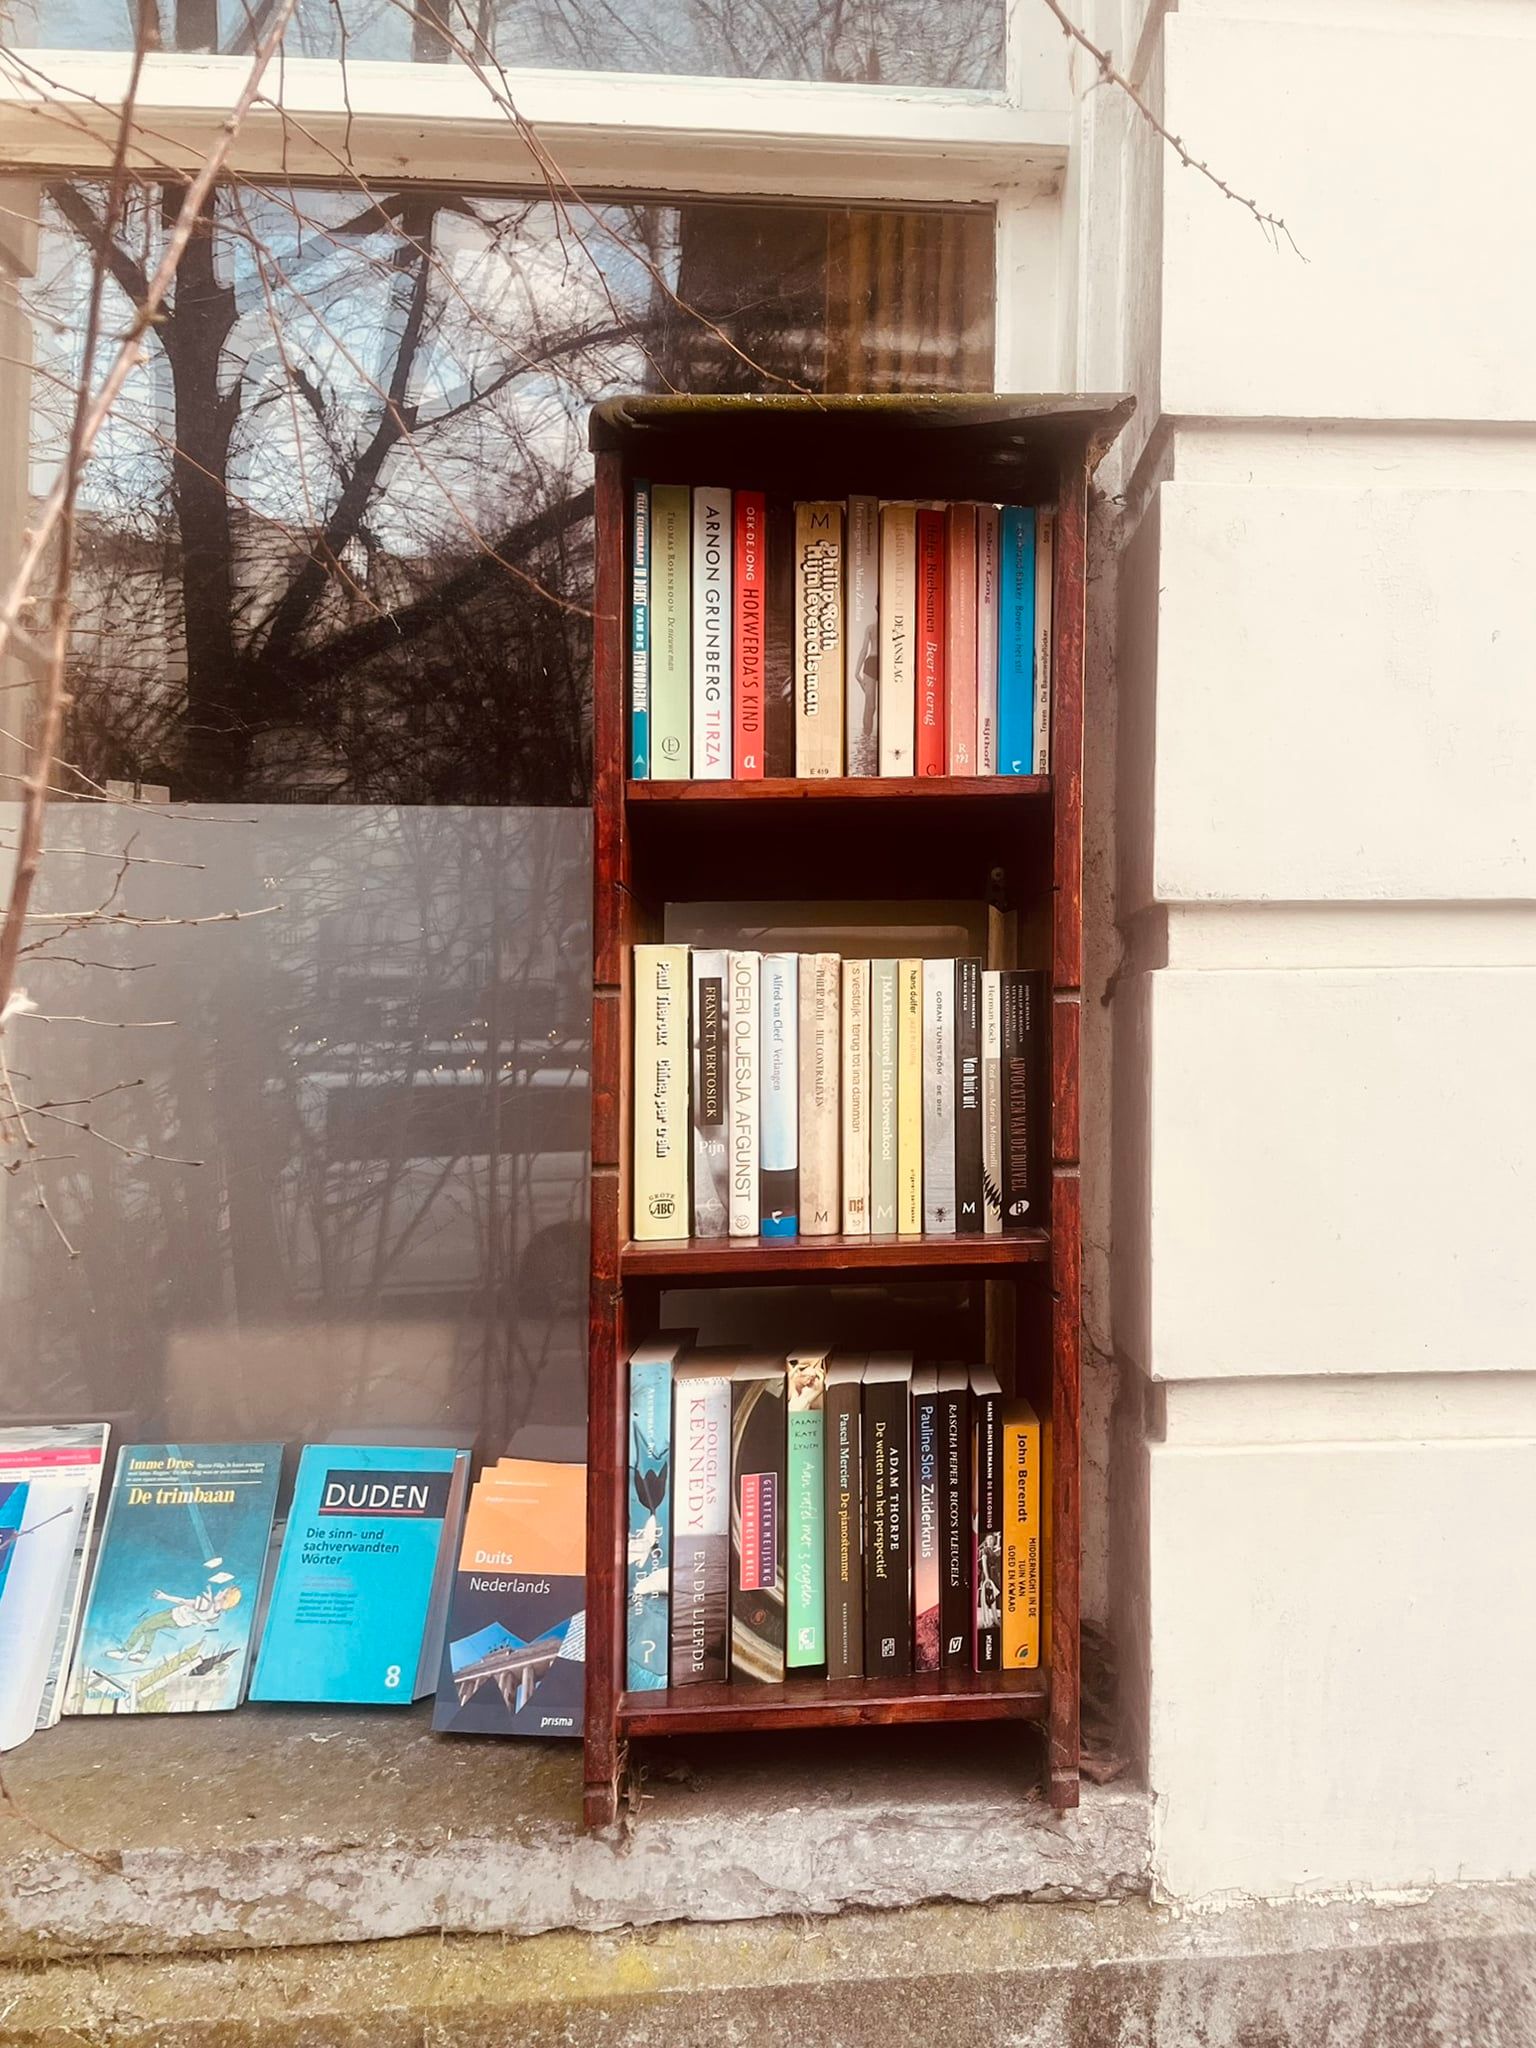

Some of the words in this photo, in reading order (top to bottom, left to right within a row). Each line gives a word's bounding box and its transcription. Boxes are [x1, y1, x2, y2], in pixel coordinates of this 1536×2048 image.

[636, 492, 647, 513] FELIX
[746, 507, 755, 528] OEK
[706, 506, 720, 580] ARNON
[746, 533, 755, 546] DE
[634, 568, 647, 576] IN
[746, 549, 755, 580] JONG
[801, 545, 823, 585] Mijn
[818, 540, 839, 602] Philip
[634, 579, 647, 606] DIENST
[856, 568, 864, 590] Maria
[927, 564, 937, 632] Ruebsamen
[636, 608, 644, 631] VAN
[668, 617, 675, 627] De
[805, 588, 822, 639] leven
[819, 604, 839, 650] Roth
[1015, 606, 1023, 631] Boven
[635, 634, 644, 648] DE
[706, 589, 720, 701] GRUNBERG
[743, 589, 759, 688] HOKWERDA'S
[805, 641, 822, 672] als
[926, 641, 938, 672] Beer
[633, 651, 646, 713] VERWONDERING
[805, 674, 819, 716] man
[926, 676, 936, 687] is
[743, 696, 758, 732] KIND
[924, 692, 936, 725] terug
[706, 710, 720, 766] TIRZA
[657, 962, 671, 990] Paul
[736, 961, 751, 1014] JOERI
[774, 974, 783, 1000] Alfred
[816, 970, 824, 996] PHILIP
[706, 987, 716, 1028] FRANK
[816, 999, 824, 1020] ROTH
[851, 977, 861, 1016] vestdijk
[910, 991, 918, 1014] dulfer
[657, 994, 671, 1046] Theroux
[774, 1020, 783, 1041] Cleef
[706, 1031, 716, 1042] T.
[816, 1030, 824, 1045] HET
[850, 1024, 861, 1051] terug
[735, 1021, 751, 1103] OLJESJA
[770, 1049, 783, 1091] Verlangen
[853, 1054, 861, 1067] tot
[963, 1057, 978, 1072] Van
[655, 1060, 671, 1098] China,
[706, 1045, 717, 1117] VERTOSICK
[882, 1070, 893, 1081] In
[963, 1076, 978, 1093] huis
[1010, 1057, 1026, 1113] ADVOCATEN
[882, 1083, 893, 1097] de
[936, 1085, 942, 1095] DE
[963, 1096, 978, 1108] uit
[655, 1100, 667, 1123] per
[852, 1087, 861, 1133] damman
[1010, 1117, 1026, 1135] VAN
[699, 1140, 725, 1156] Pijn
[735, 1111, 751, 1202] AFGUNST
[989, 1125, 997, 1167] Montanelli
[1011, 1138, 1026, 1151] DE
[1011, 1155, 1026, 1191] DUIVEL
[840, 1413, 849, 1445] Pascal
[876, 1422, 886, 1437] De
[921, 1406, 933, 1452] Pauline
[948, 1404, 957, 1448] RASCHA
[707, 1421, 718, 1504] DOUGLAS
[876, 1440, 886, 1473] wetten
[1017, 1434, 1027, 1464] John
[128, 1458, 165, 1471] Imme
[166, 1457, 195, 1470] Dros
[688, 1399, 705, 1529] KENNEDY
[801, 1461, 815, 1488] Aan
[840, 1447, 849, 1488] Mercier
[889, 1447, 898, 1487] ADAM
[921, 1454, 933, 1479] Slot
[949, 1451, 958, 1485] PEPER
[128, 1487, 152, 1505] De
[156, 1486, 236, 1505] trimbaan
[325, 1483, 429, 1508] DUDEN
[746, 1481, 755, 1516] TUSSEN
[876, 1474, 884, 1497] van
[987, 1481, 992, 1490] DE
[1018, 1470, 1028, 1522] Berendt
[763, 1480, 771, 1526] GEERTEN
[800, 1492, 817, 1520] tafel
[841, 1493, 850, 1508] De
[876, 1500, 887, 1517] het
[950, 1491, 958, 1527] RICO'S
[306, 1527, 324, 1539] Die
[328, 1529, 358, 1539] sinn-
[361, 1529, 384, 1540] und
[746, 1522, 755, 1539] MES
[890, 1494, 899, 1551] THORPE
[921, 1484, 934, 1557] Zuiderkruis
[303, 1540, 400, 1554] sachverwandten
[746, 1543, 755, 1555] EN
[801, 1525, 811, 1548] met
[838, 1510, 850, 1582] pianostemmer
[874, 1520, 887, 1579] perspectief
[301, 1553, 343, 1565] Wörter
[474, 1550, 513, 1565] Duits
[694, 1551, 705, 1573] EN
[761, 1532, 771, 1581] MEIJSING
[950, 1530, 959, 1587] VLEUGELS
[1008, 1545, 1016, 1567] GOED
[1028, 1537, 1036, 1593] MIDDERNACHT
[470, 1577, 551, 1594] Nederlands
[795, 1562, 818, 1608] engelen
[1008, 1570, 1016, 1580] EN
[693, 1580, 705, 1602] DE
[1008, 1583, 1016, 1613] KWAAD
[1029, 1597, 1036, 1605] IN
[1029, 1608, 1036, 1617] DE
[692, 1609, 705, 1672] LIEFDE
[384, 1664, 401, 1688] 8
[541, 1717, 574, 1728] prisma
